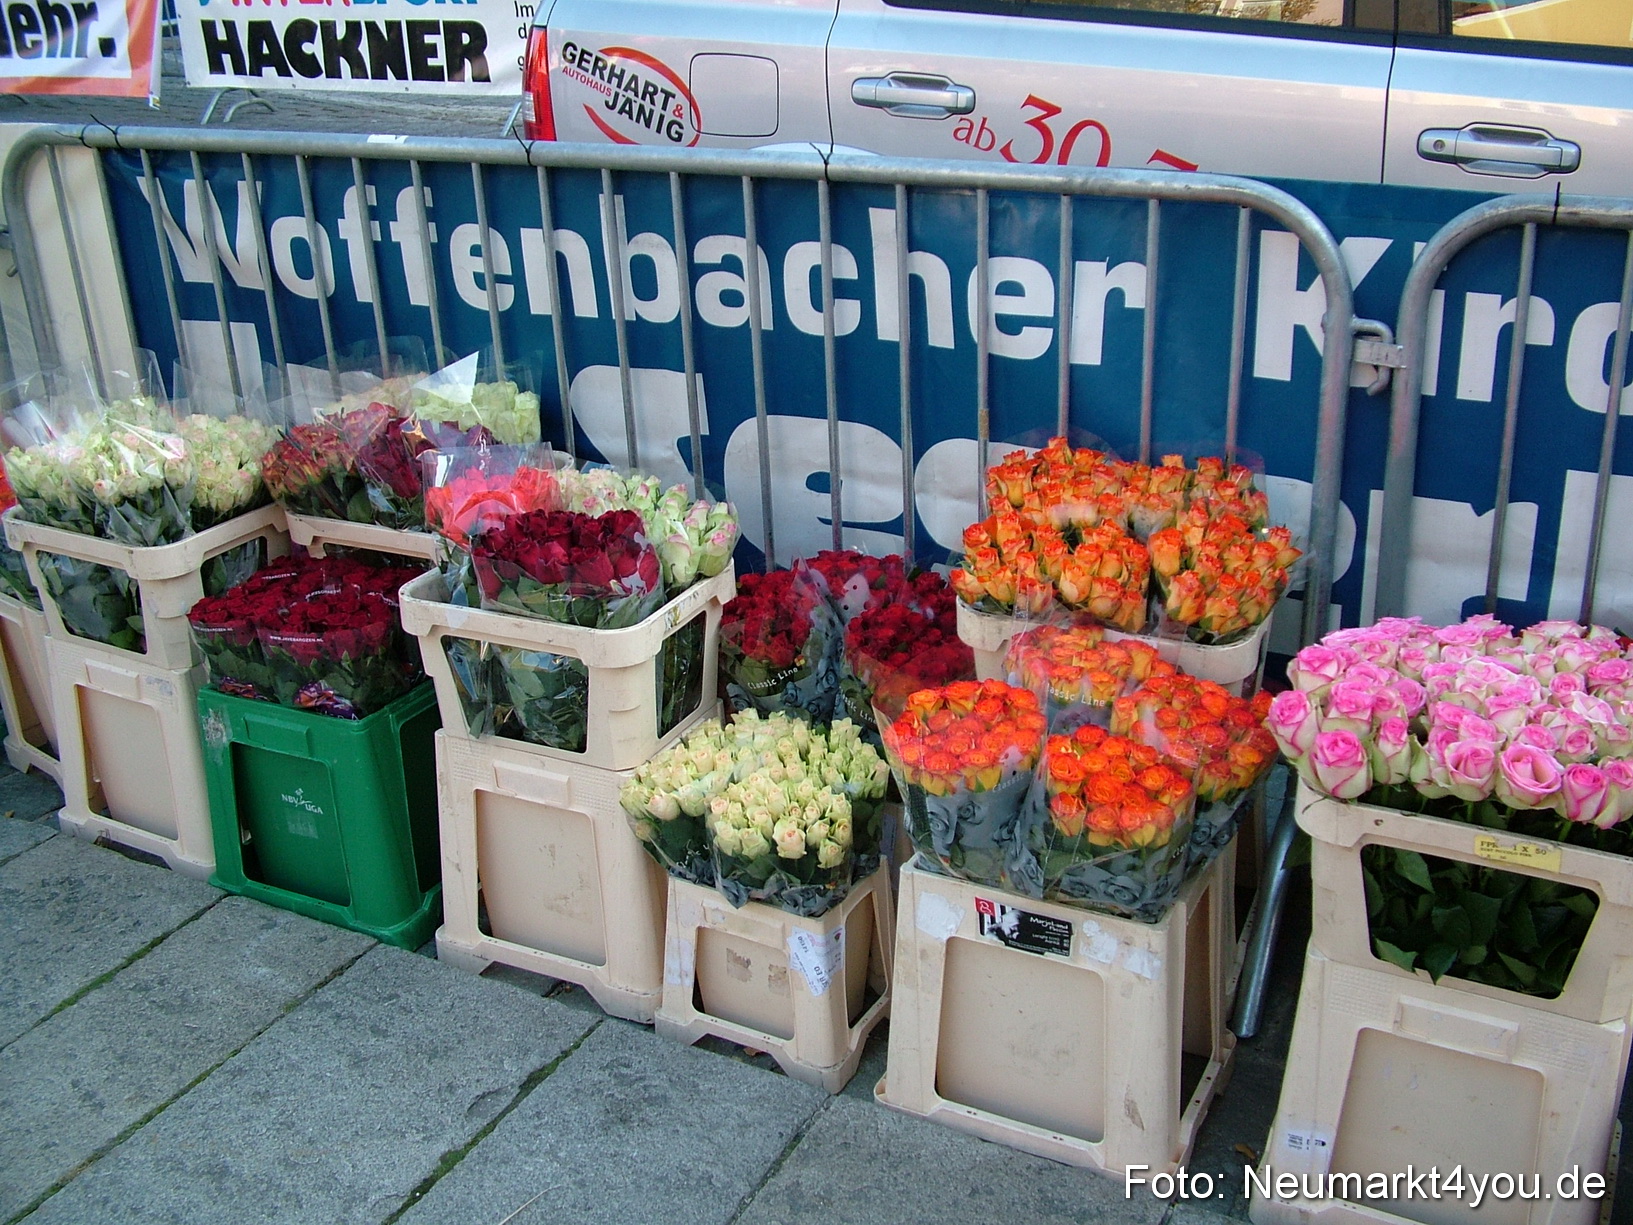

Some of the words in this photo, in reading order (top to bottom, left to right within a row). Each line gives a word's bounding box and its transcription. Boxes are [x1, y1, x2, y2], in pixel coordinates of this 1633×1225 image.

[0, 0, 117, 59] ehr.
[201, 17, 491, 83] HACKNER
[562, 41, 676, 112] GERHART
[672, 103, 684, 120] &
[562, 65, 612, 97] AUTOHAUS
[604, 91, 685, 143] JÄNIG
[952, 117, 997, 152] ab
[136, 175, 1147, 366] Woffenbacher
[1081, 694, 1106, 707] Line
